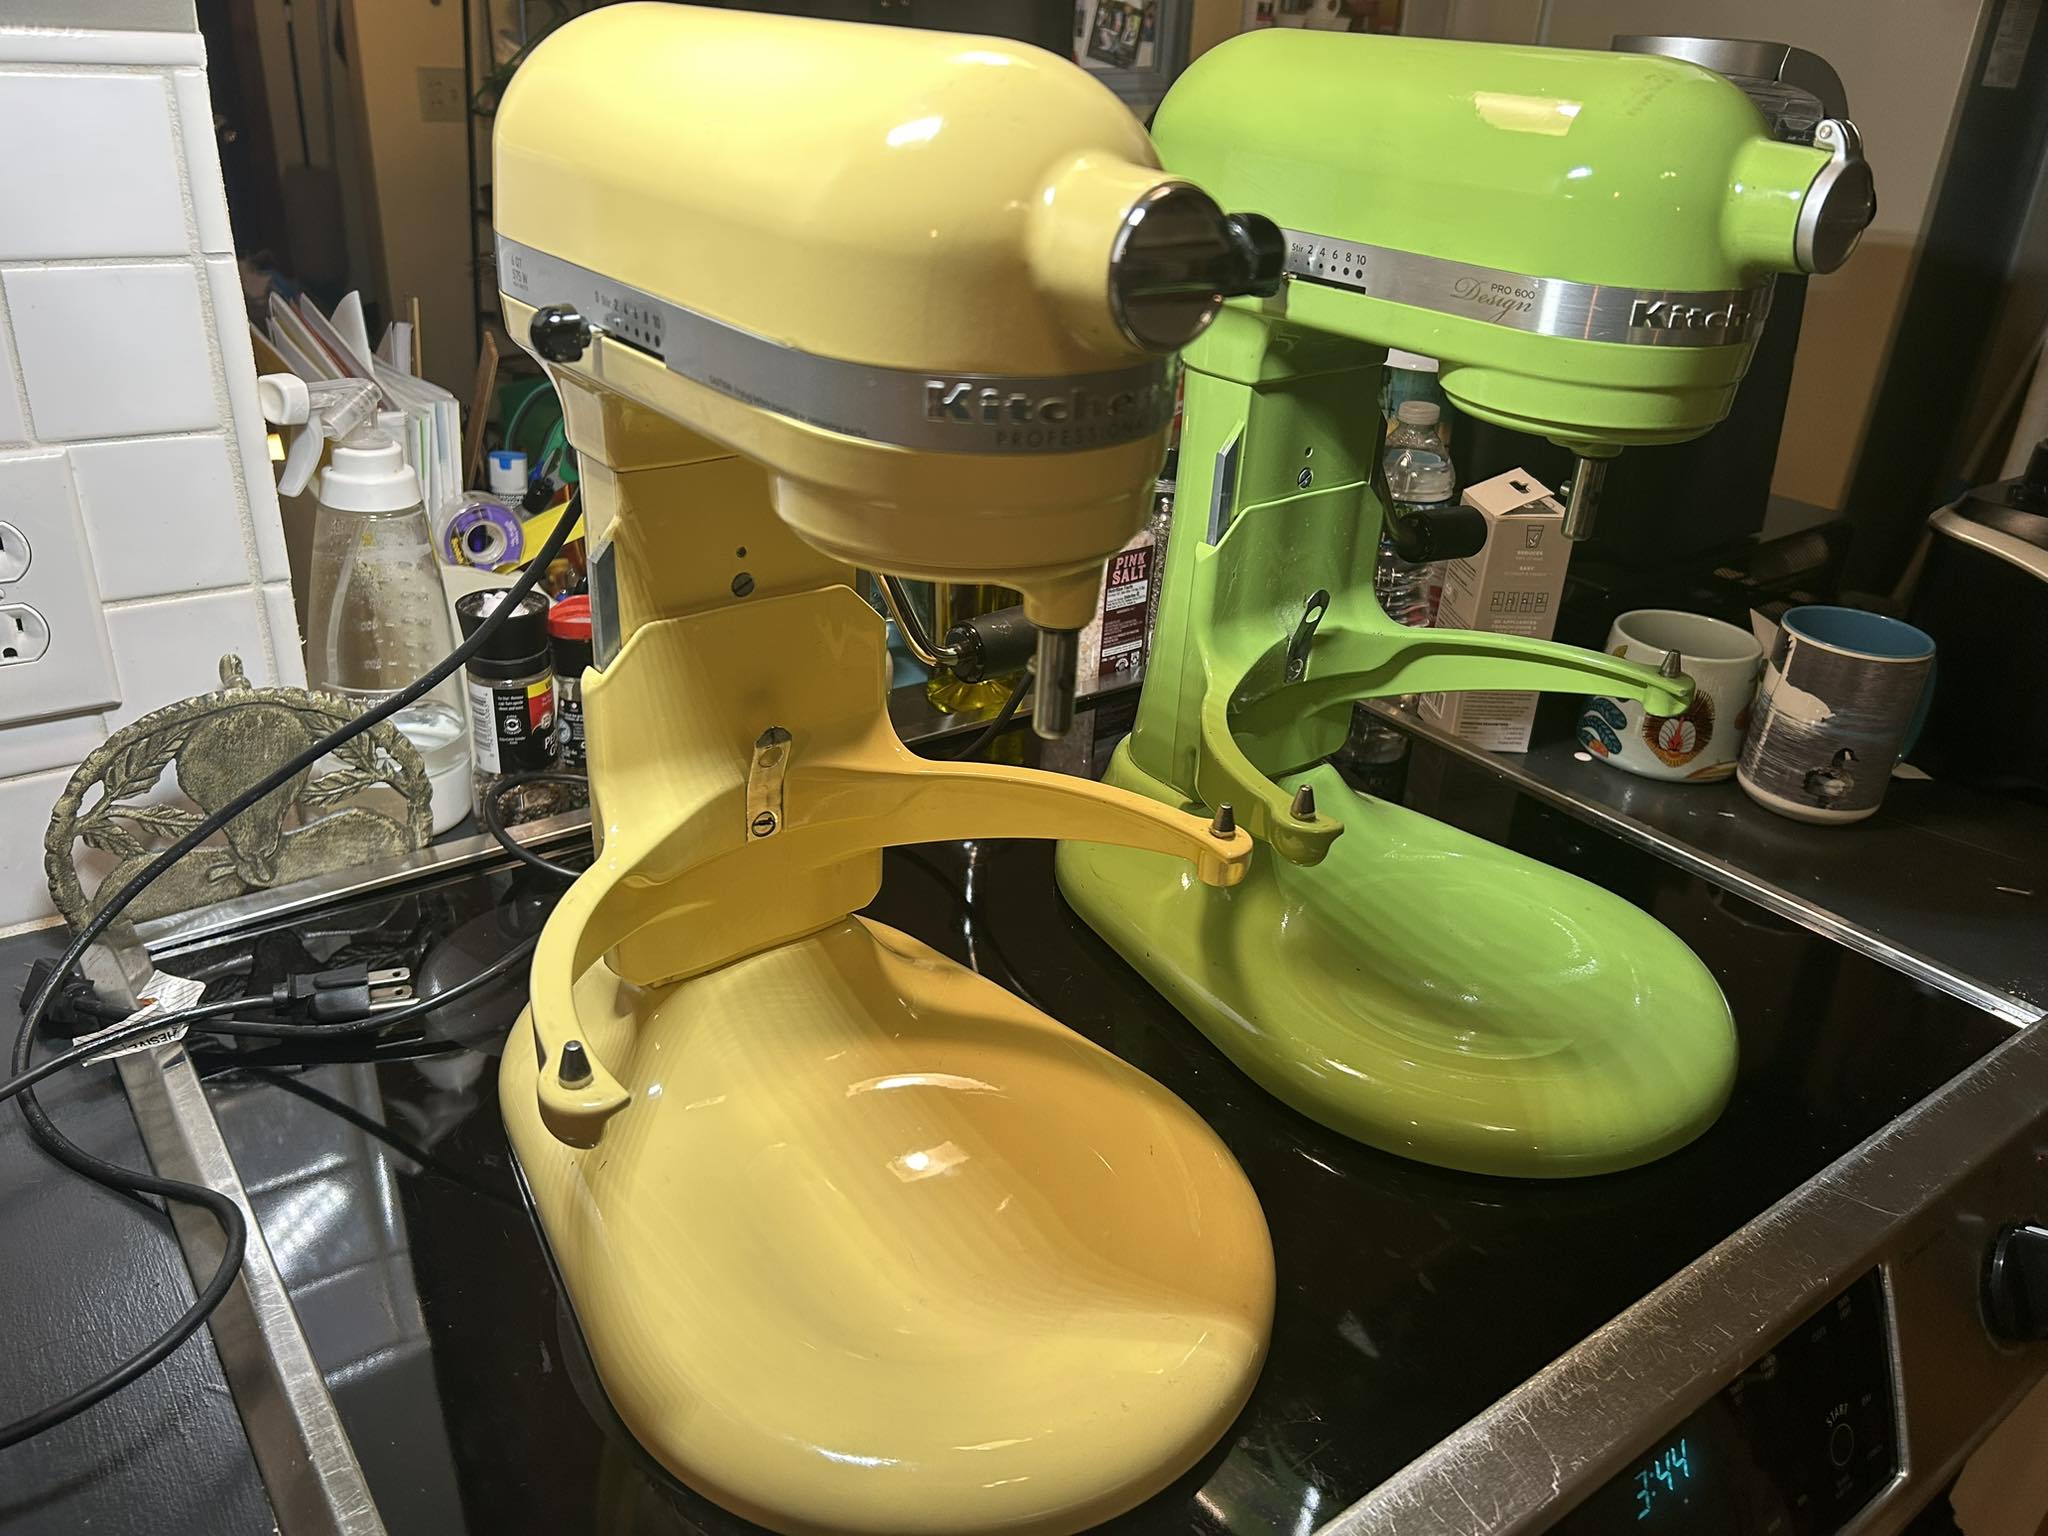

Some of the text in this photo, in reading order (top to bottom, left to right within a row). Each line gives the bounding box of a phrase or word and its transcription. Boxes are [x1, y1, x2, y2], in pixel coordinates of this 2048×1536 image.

[1292, 243, 1367, 266] Stir 2 4 6 8 10
[1449, 277, 1534, 323] Design
[1491, 283, 1535, 300] PRO 600
[1115, 552, 1147, 570] PINK
[1112, 564, 1147, 586] SALT
[1826, 1403, 1848, 1427] START
[1634, 1438, 1690, 1520] 3:44
